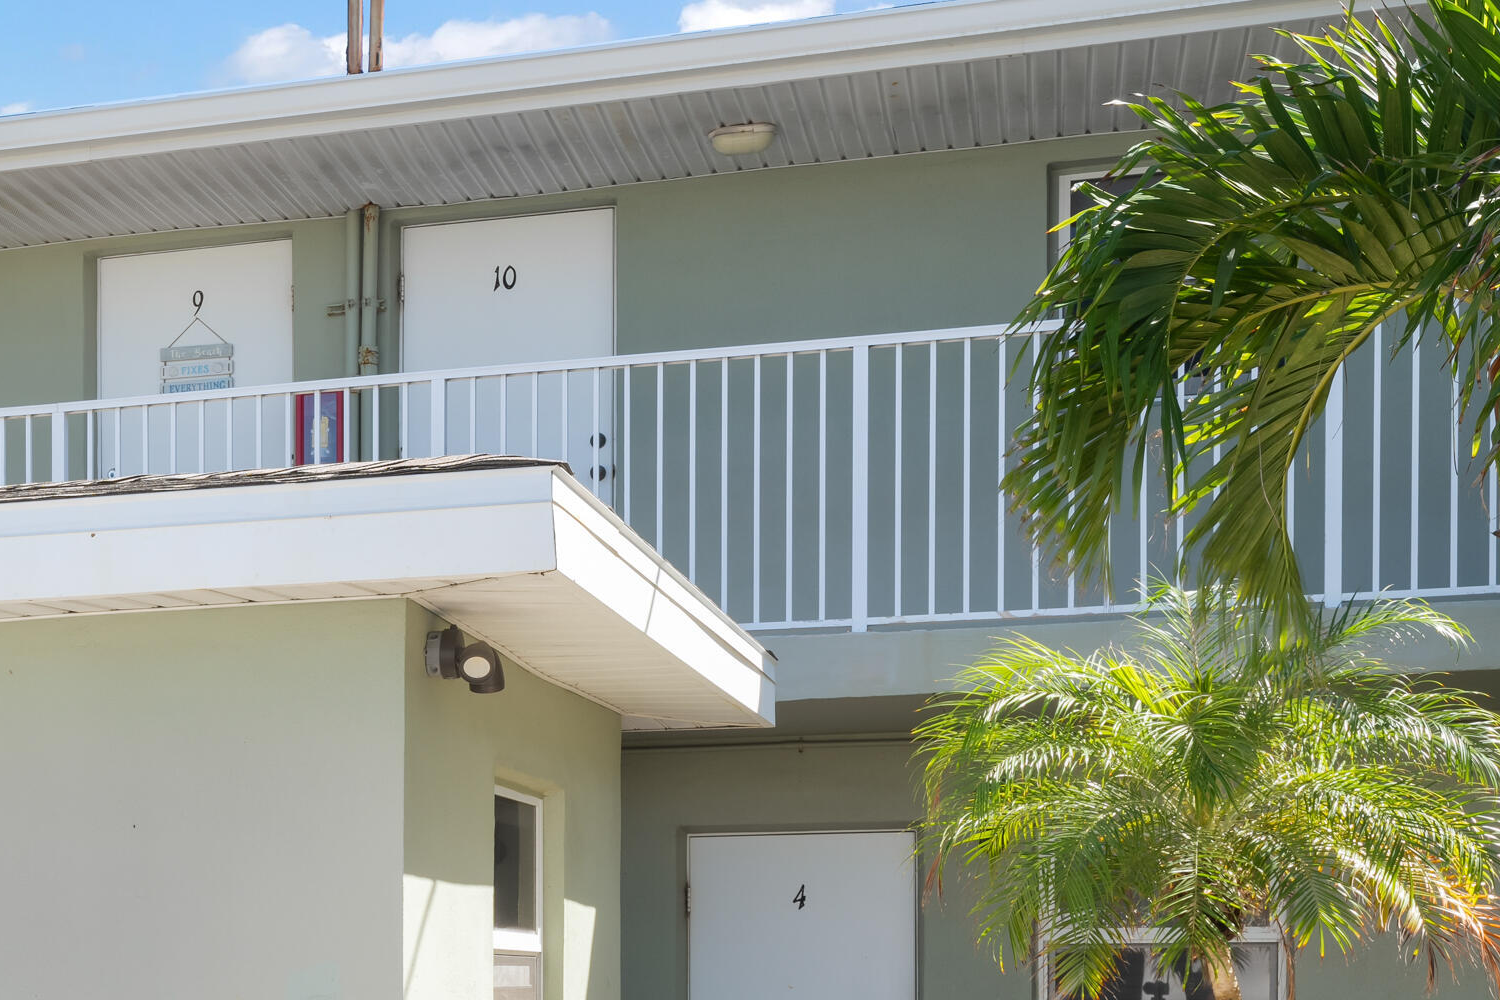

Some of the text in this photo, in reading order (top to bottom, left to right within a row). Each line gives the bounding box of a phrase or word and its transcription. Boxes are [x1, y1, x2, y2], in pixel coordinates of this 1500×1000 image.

[493, 265, 517, 292] 10
[192, 290, 204, 316] 9
[181, 365, 210, 376] FIXES
[169, 380, 226, 393] EVERYTHING
[792, 884, 806, 910] 4
